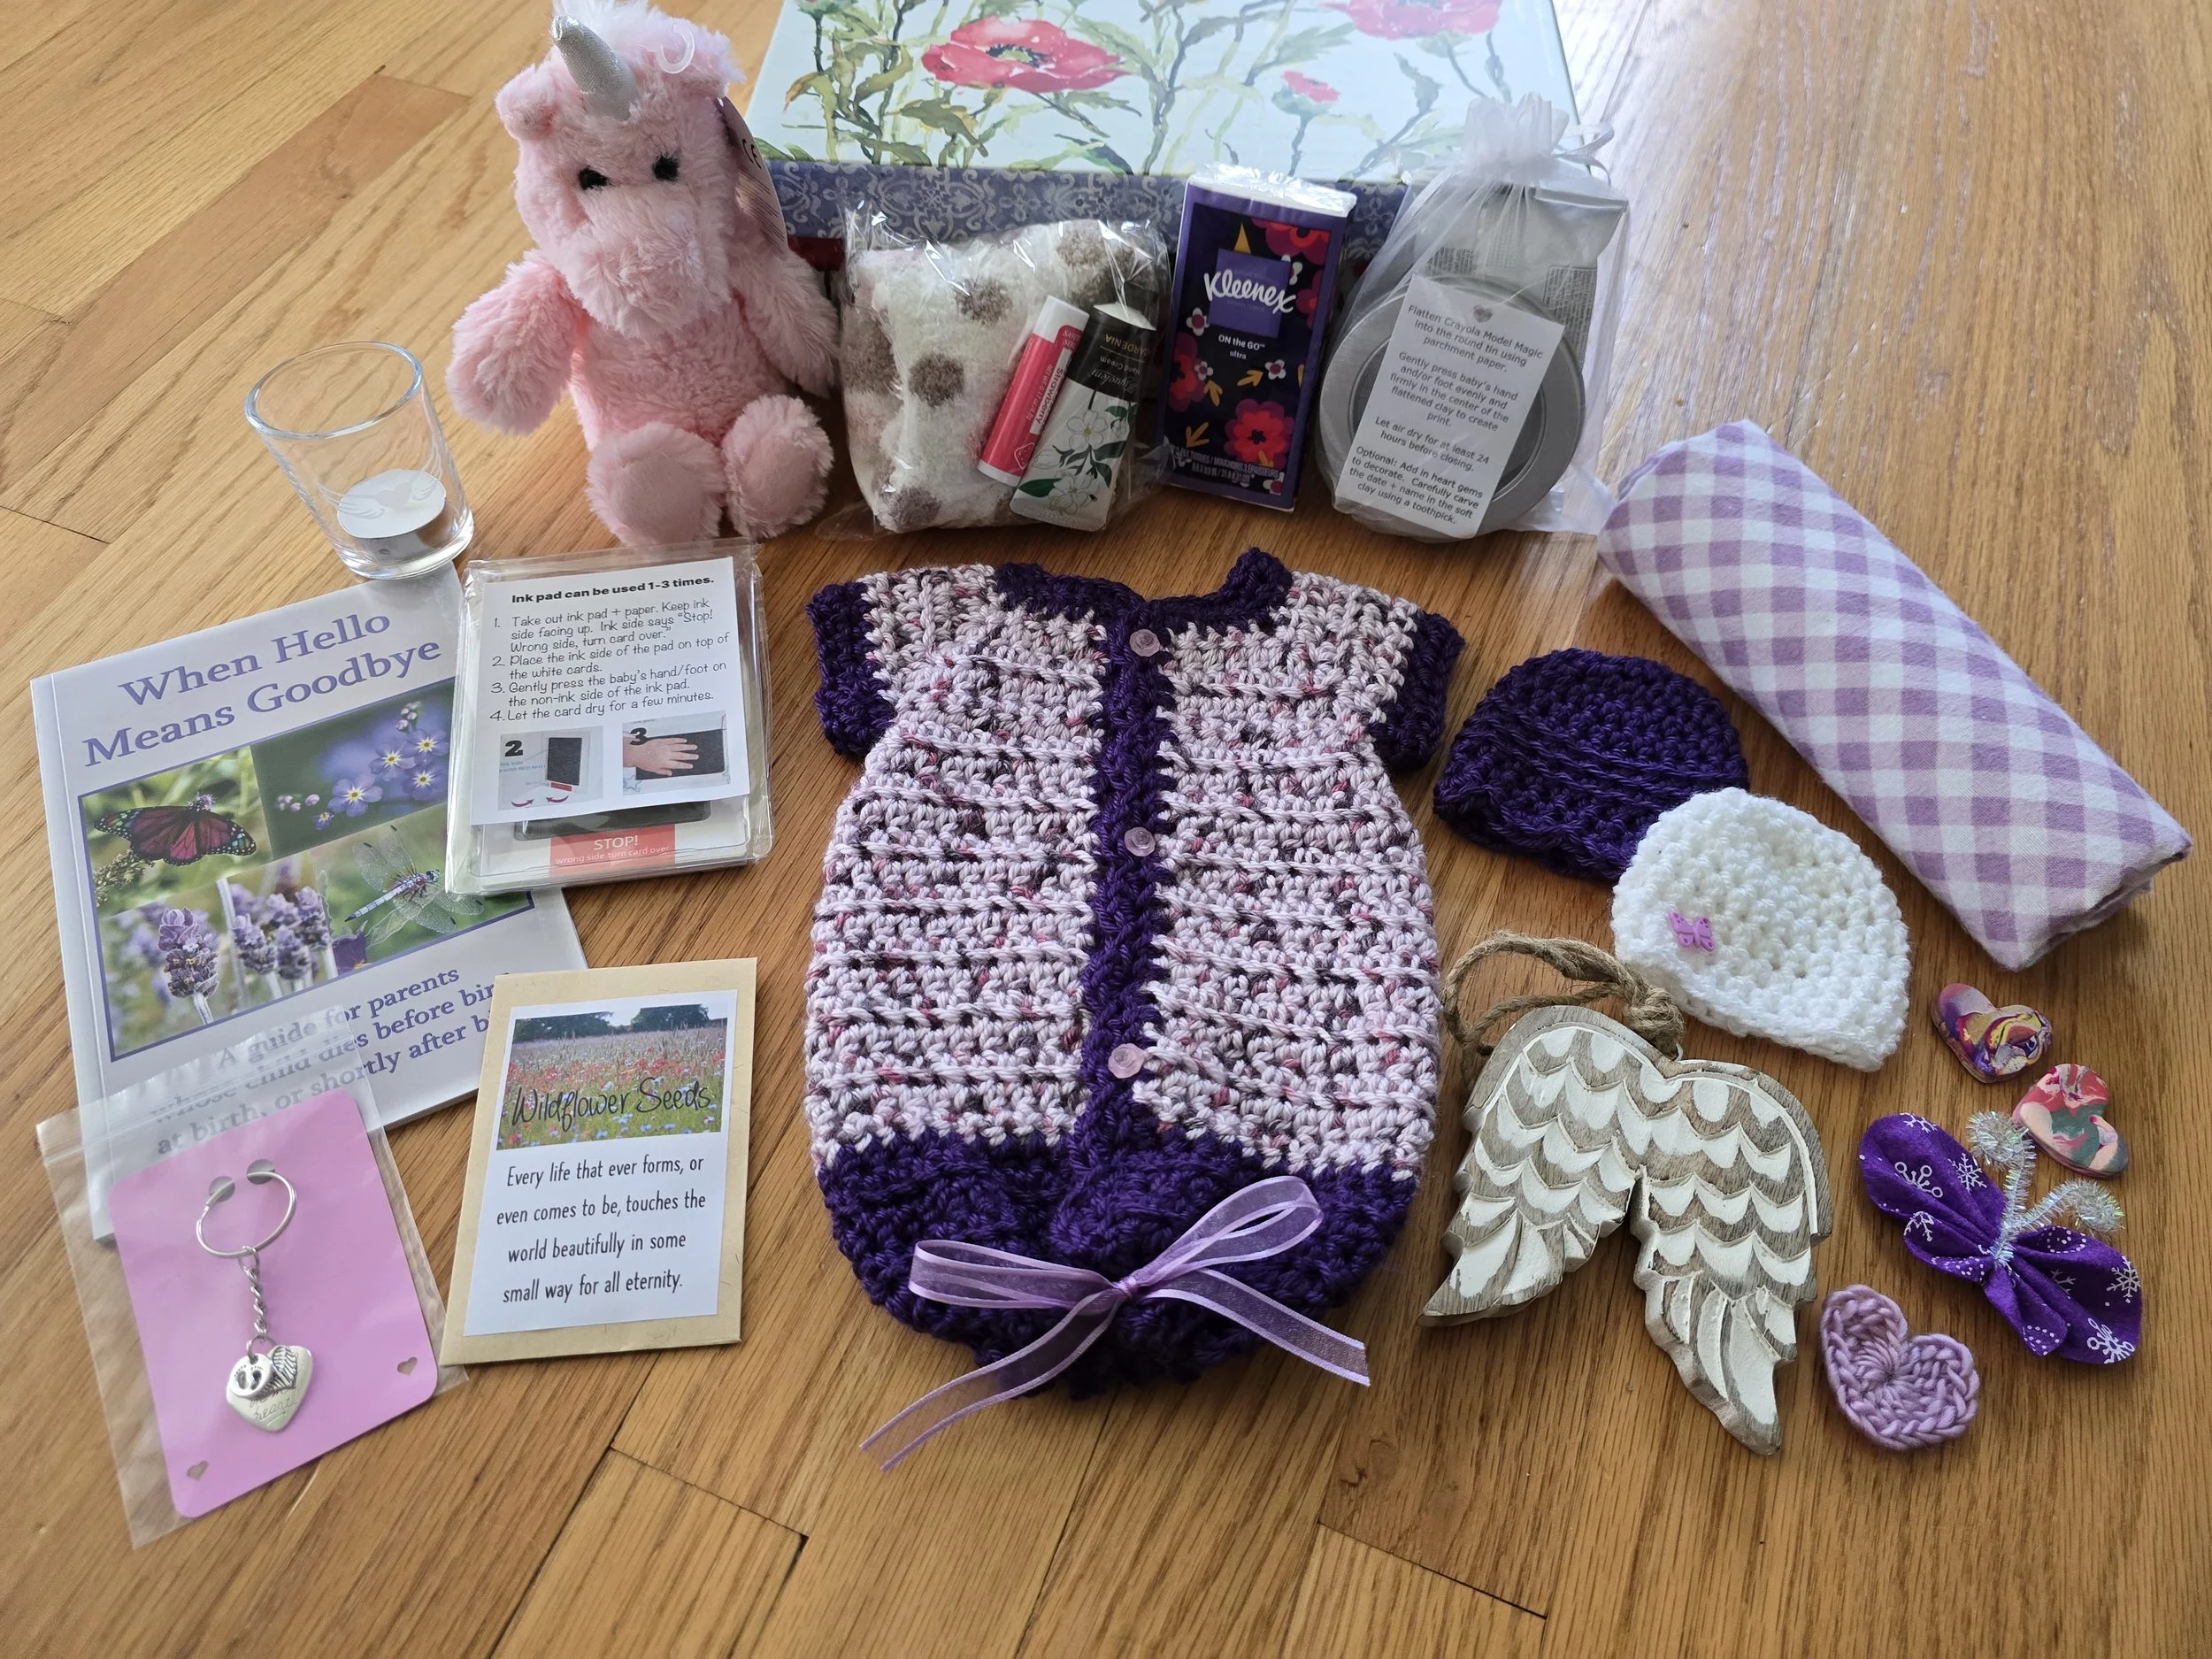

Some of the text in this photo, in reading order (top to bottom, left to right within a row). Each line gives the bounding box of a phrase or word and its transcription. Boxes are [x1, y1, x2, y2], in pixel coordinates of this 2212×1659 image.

[1203, 269, 1296, 314] Kleenex
[1233, 338, 1246, 348] the
[1409, 304, 1543, 359] Flatten Crayola Model Magic
[1435, 327, 1453, 340] the
[1455, 334, 1485, 350] round
[1485, 343, 1500, 356] tin
[1501, 350, 1527, 368] using
[1100, 356, 1141, 375] Hand Cream
[1230, 350, 1247, 359] ultra
[1423, 336, 1508, 373] parchment paper.
[1399, 351, 1518, 400] Gently press baby's hand
[1401, 365, 1508, 409] and/or foot evenly and
[1035, 368, 1064, 426] Strawberry
[1391, 386, 1498, 432] flattened clay to create
[1380, 431, 1474, 472] hours before closing.
[1352, 457, 1479, 510] to decorate. Carefully carve
[1356, 446, 1483, 499] Optional: Add in heart gems
[1357, 481, 1377, 497] clay
[1379, 488, 1403, 506] using
[1412, 499, 1456, 526] toothpick.
[536, 592, 562, 603] pad
[612, 584, 645, 593] used
[649, 580, 670, 590] 1-3
[672, 577, 714, 588] times.
[495, 618, 500, 627] 1.
[512, 616, 541, 626] Take
[546, 615, 564, 625] out
[567, 613, 584, 623] ink
[588, 611, 607, 623] pad
[626, 606, 658, 619] paper.
[663, 602, 689, 612] Keep
[694, 599, 710, 608] ink
[119, 614, 391, 706] When Hello
[492, 657, 505, 666] 2.
[511, 654, 543, 665] Place
[548, 653, 565, 664] the
[568, 651, 586, 661] ink
[590, 649, 612, 659] side
[617, 646, 628, 657] of
[633, 645, 650, 655] the
[654, 641, 673, 655] pad
[696, 637, 713, 649] top
[718, 634, 730, 643] of
[511, 641, 548, 655] Wrong
[552, 640, 578, 650] side,
[582, 637, 605, 646] turn
[610, 633, 634, 643] card
[491, 662, 726, 695] 3. Gently press the baby's hand/foot on
[510, 663, 603, 680] the white cards.
[82, 641, 442, 767] Means Goodbye
[490, 710, 504, 721] 4.
[508, 710, 527, 720] Let
[532, 707, 549, 718] the
[554, 704, 580, 716] card
[586, 703, 605, 716] dry
[610, 701, 626, 710] for
[641, 695, 663, 707] few
[667, 691, 714, 704] minutes.
[504, 741, 524, 757] 2
[630, 727, 648, 745] 3
[556, 855, 585, 865] wrong
[608, 850, 626, 859] turn
[628, 849, 648, 858] card
[594, 835, 639, 850] STOP!
[219, 1048, 238, 1064] A
[248, 1020, 318, 1064] guide
[326, 1005, 361, 1028] for
[367, 969, 460, 1025] parents
[318, 1032, 368, 1062] dies
[374, 1002, 455, 1040] before
[458, 983, 495, 1006] bir
[157, 1026, 476, 1155] at birth, or shortly after
[512, 1077, 710, 1132] Wildflower Seeds
[507, 1155, 704, 1189] Every life that ever forms, or
[496, 1188, 706, 1225] even comes to be, touches the
[508, 1232, 686, 1263] world beautifully in some
[503, 1270, 683, 1303] small way for all eternity.
